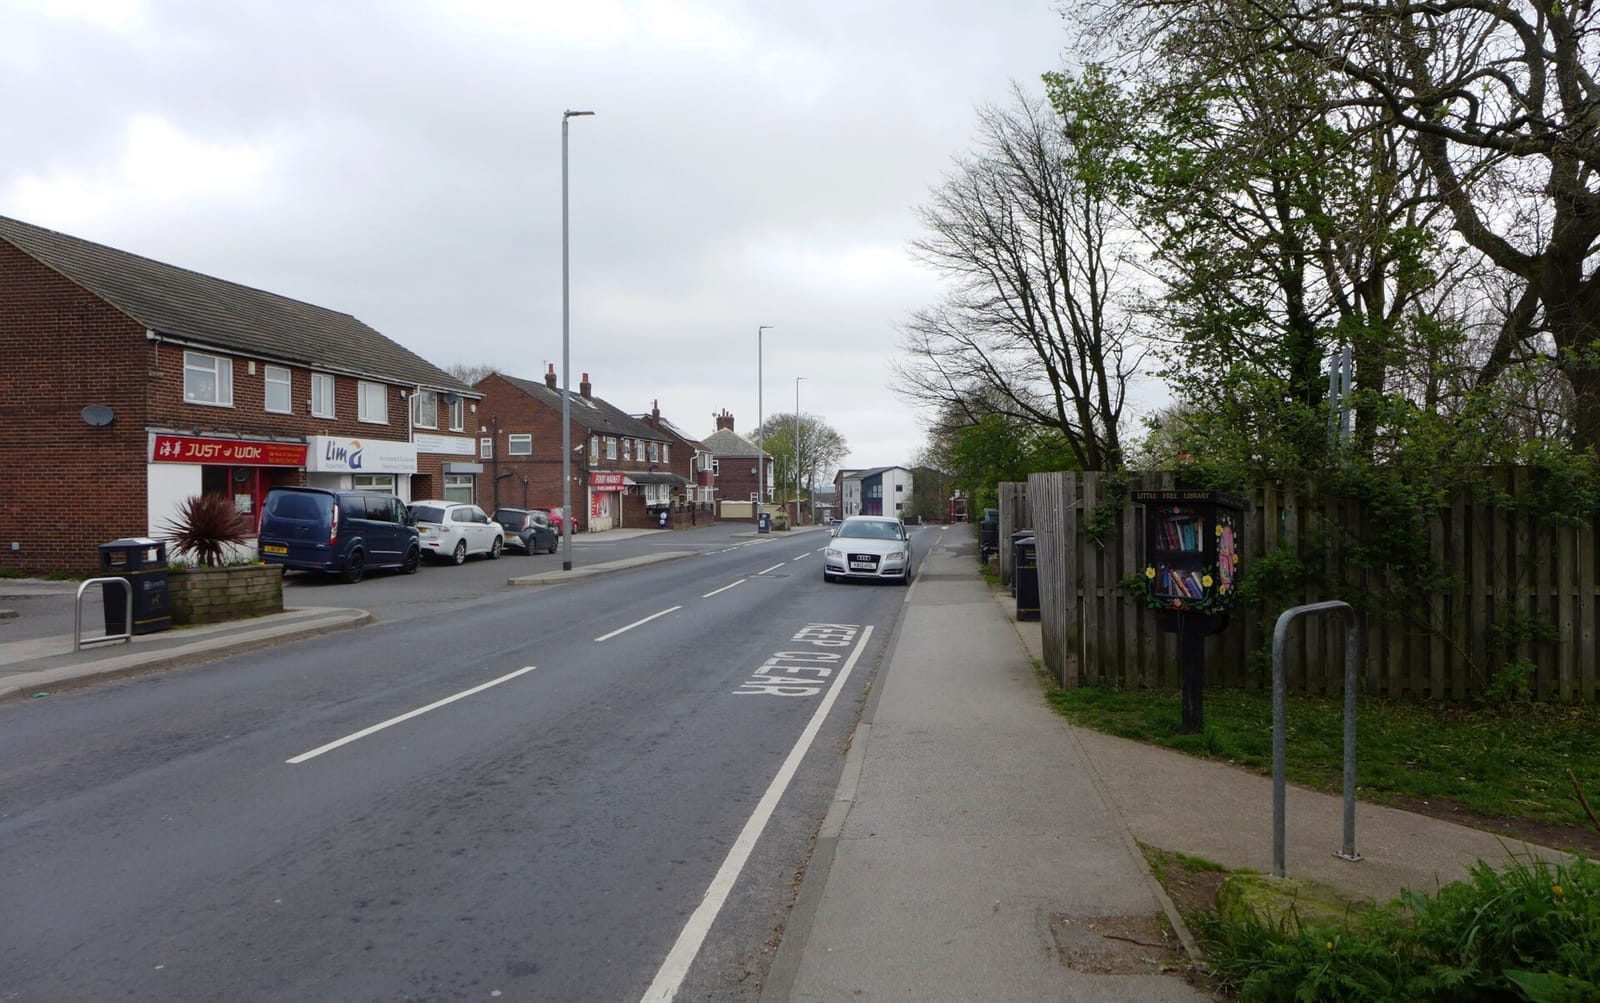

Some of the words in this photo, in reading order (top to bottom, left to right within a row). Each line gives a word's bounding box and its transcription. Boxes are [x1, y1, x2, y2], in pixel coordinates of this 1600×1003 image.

[185, 443, 222, 458] JUST
[234, 446, 262, 459] WOK
[1137, 492, 1156, 500] LITTLE
[1183, 492, 1210, 500] LIBRARY
[791, 622, 861, 647] KEEP
[731, 651, 842, 697] CLEAR
